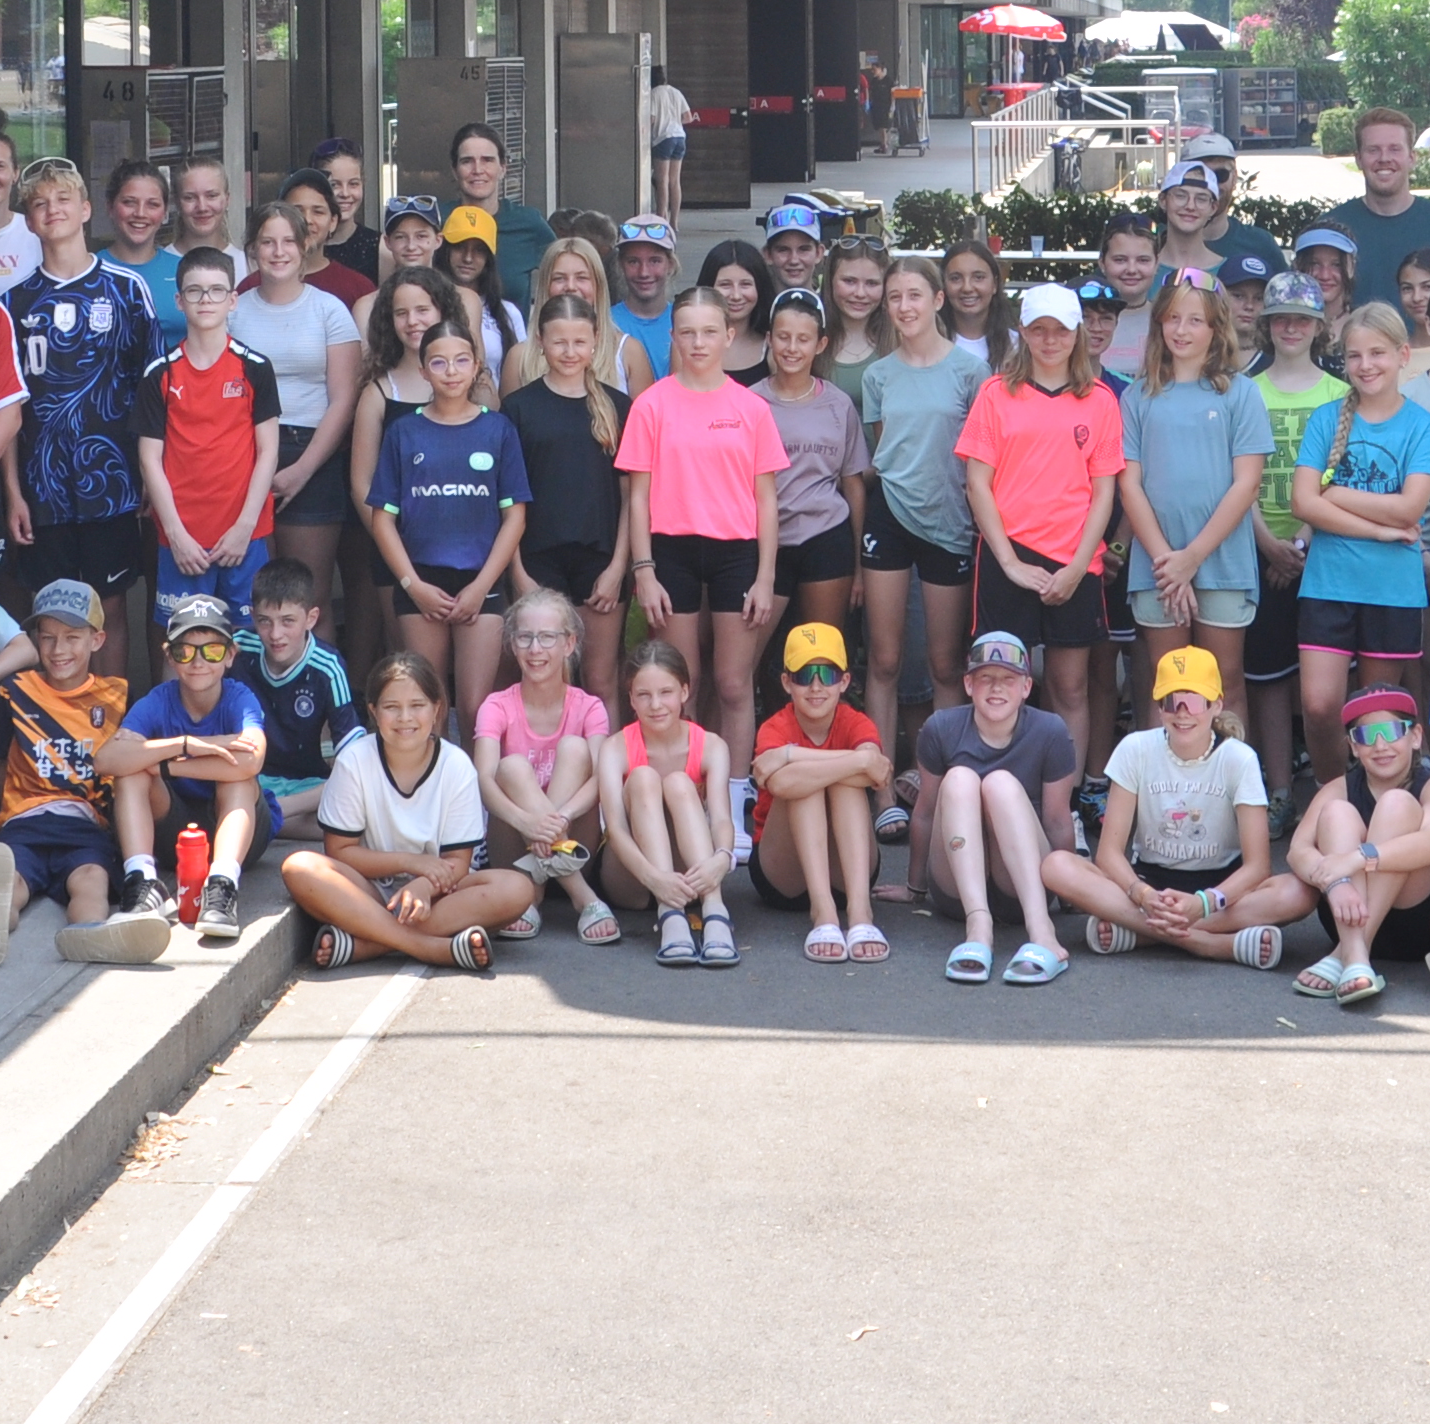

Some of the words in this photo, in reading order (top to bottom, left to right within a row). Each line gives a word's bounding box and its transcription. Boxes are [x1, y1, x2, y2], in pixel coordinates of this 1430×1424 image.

[460, 65, 480, 80] 45
[103, 80, 134, 102] 48
[760, 100, 769, 108] A
[411, 483, 490, 497] MAGMA
[1147, 780, 1179, 795] TODAY
[1144, 835, 1220, 861] FLAMAZING
